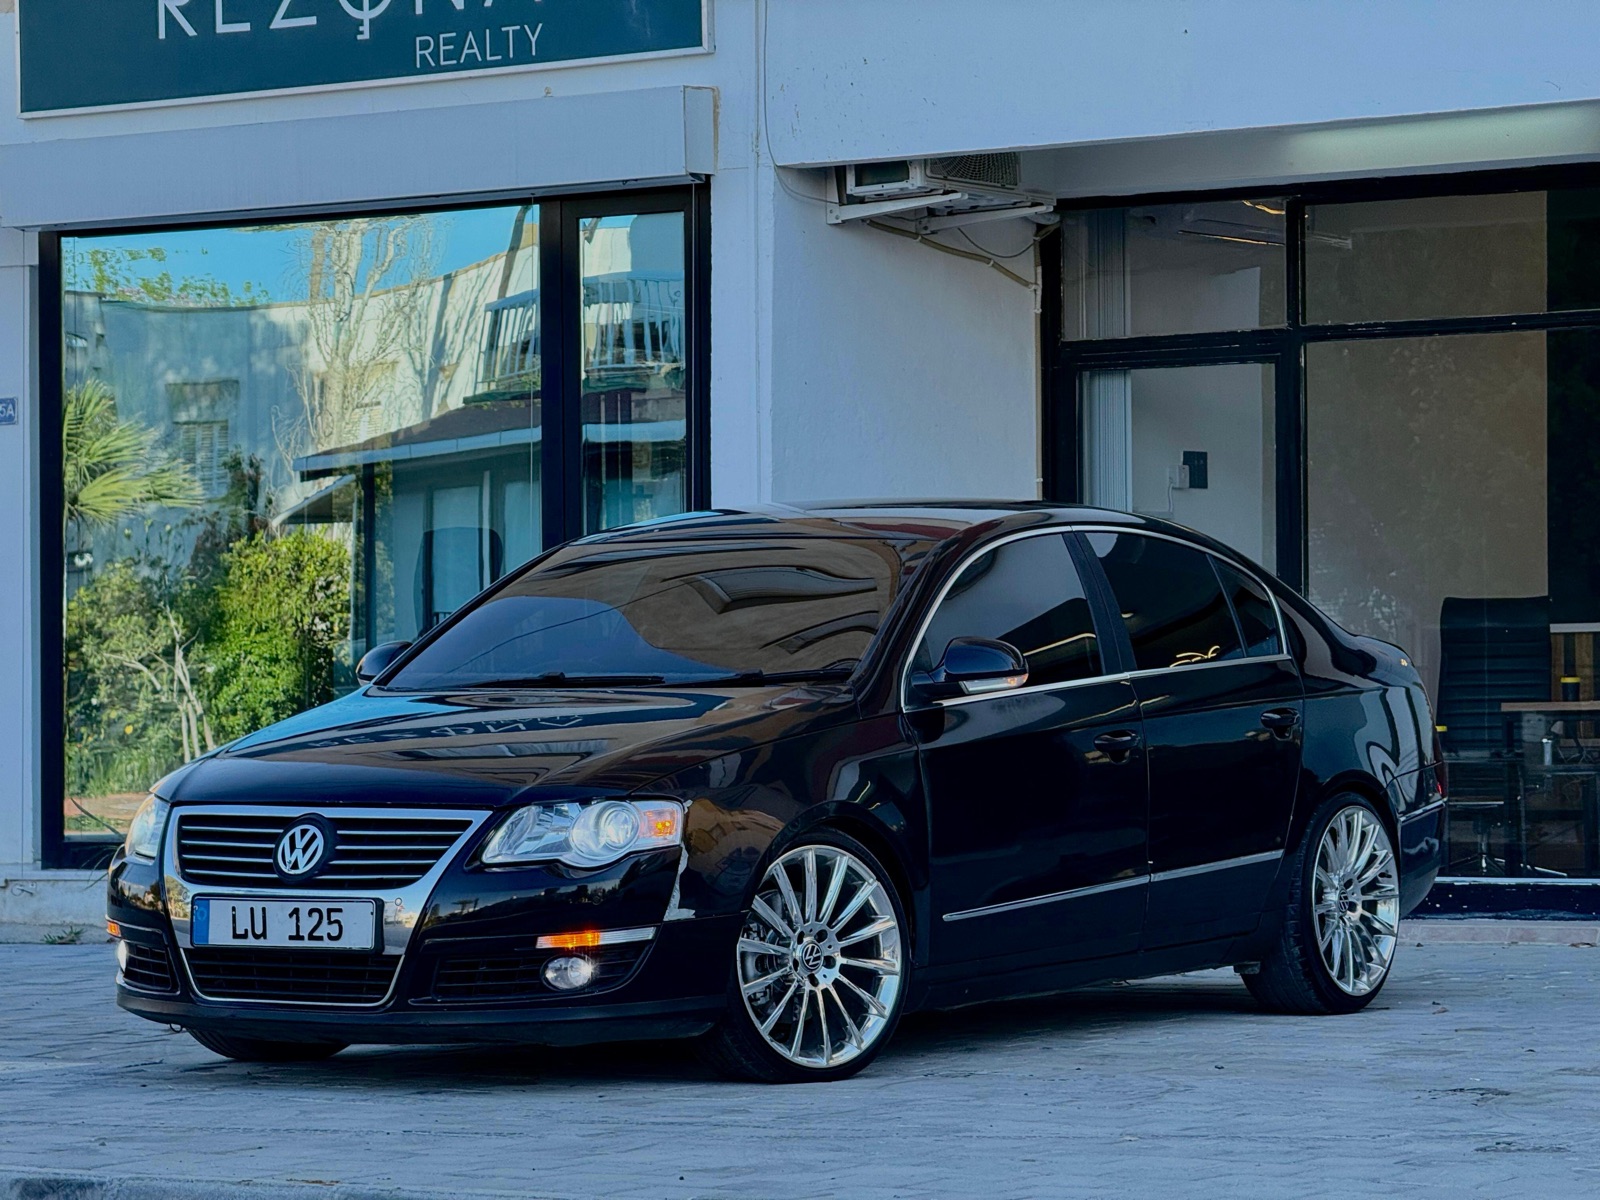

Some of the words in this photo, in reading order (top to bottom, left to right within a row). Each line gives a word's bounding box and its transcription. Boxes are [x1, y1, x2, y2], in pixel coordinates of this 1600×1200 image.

[415, 23, 543, 68] REALTY
[231, 906, 268, 939] LU
[288, 908, 344, 941] 125
